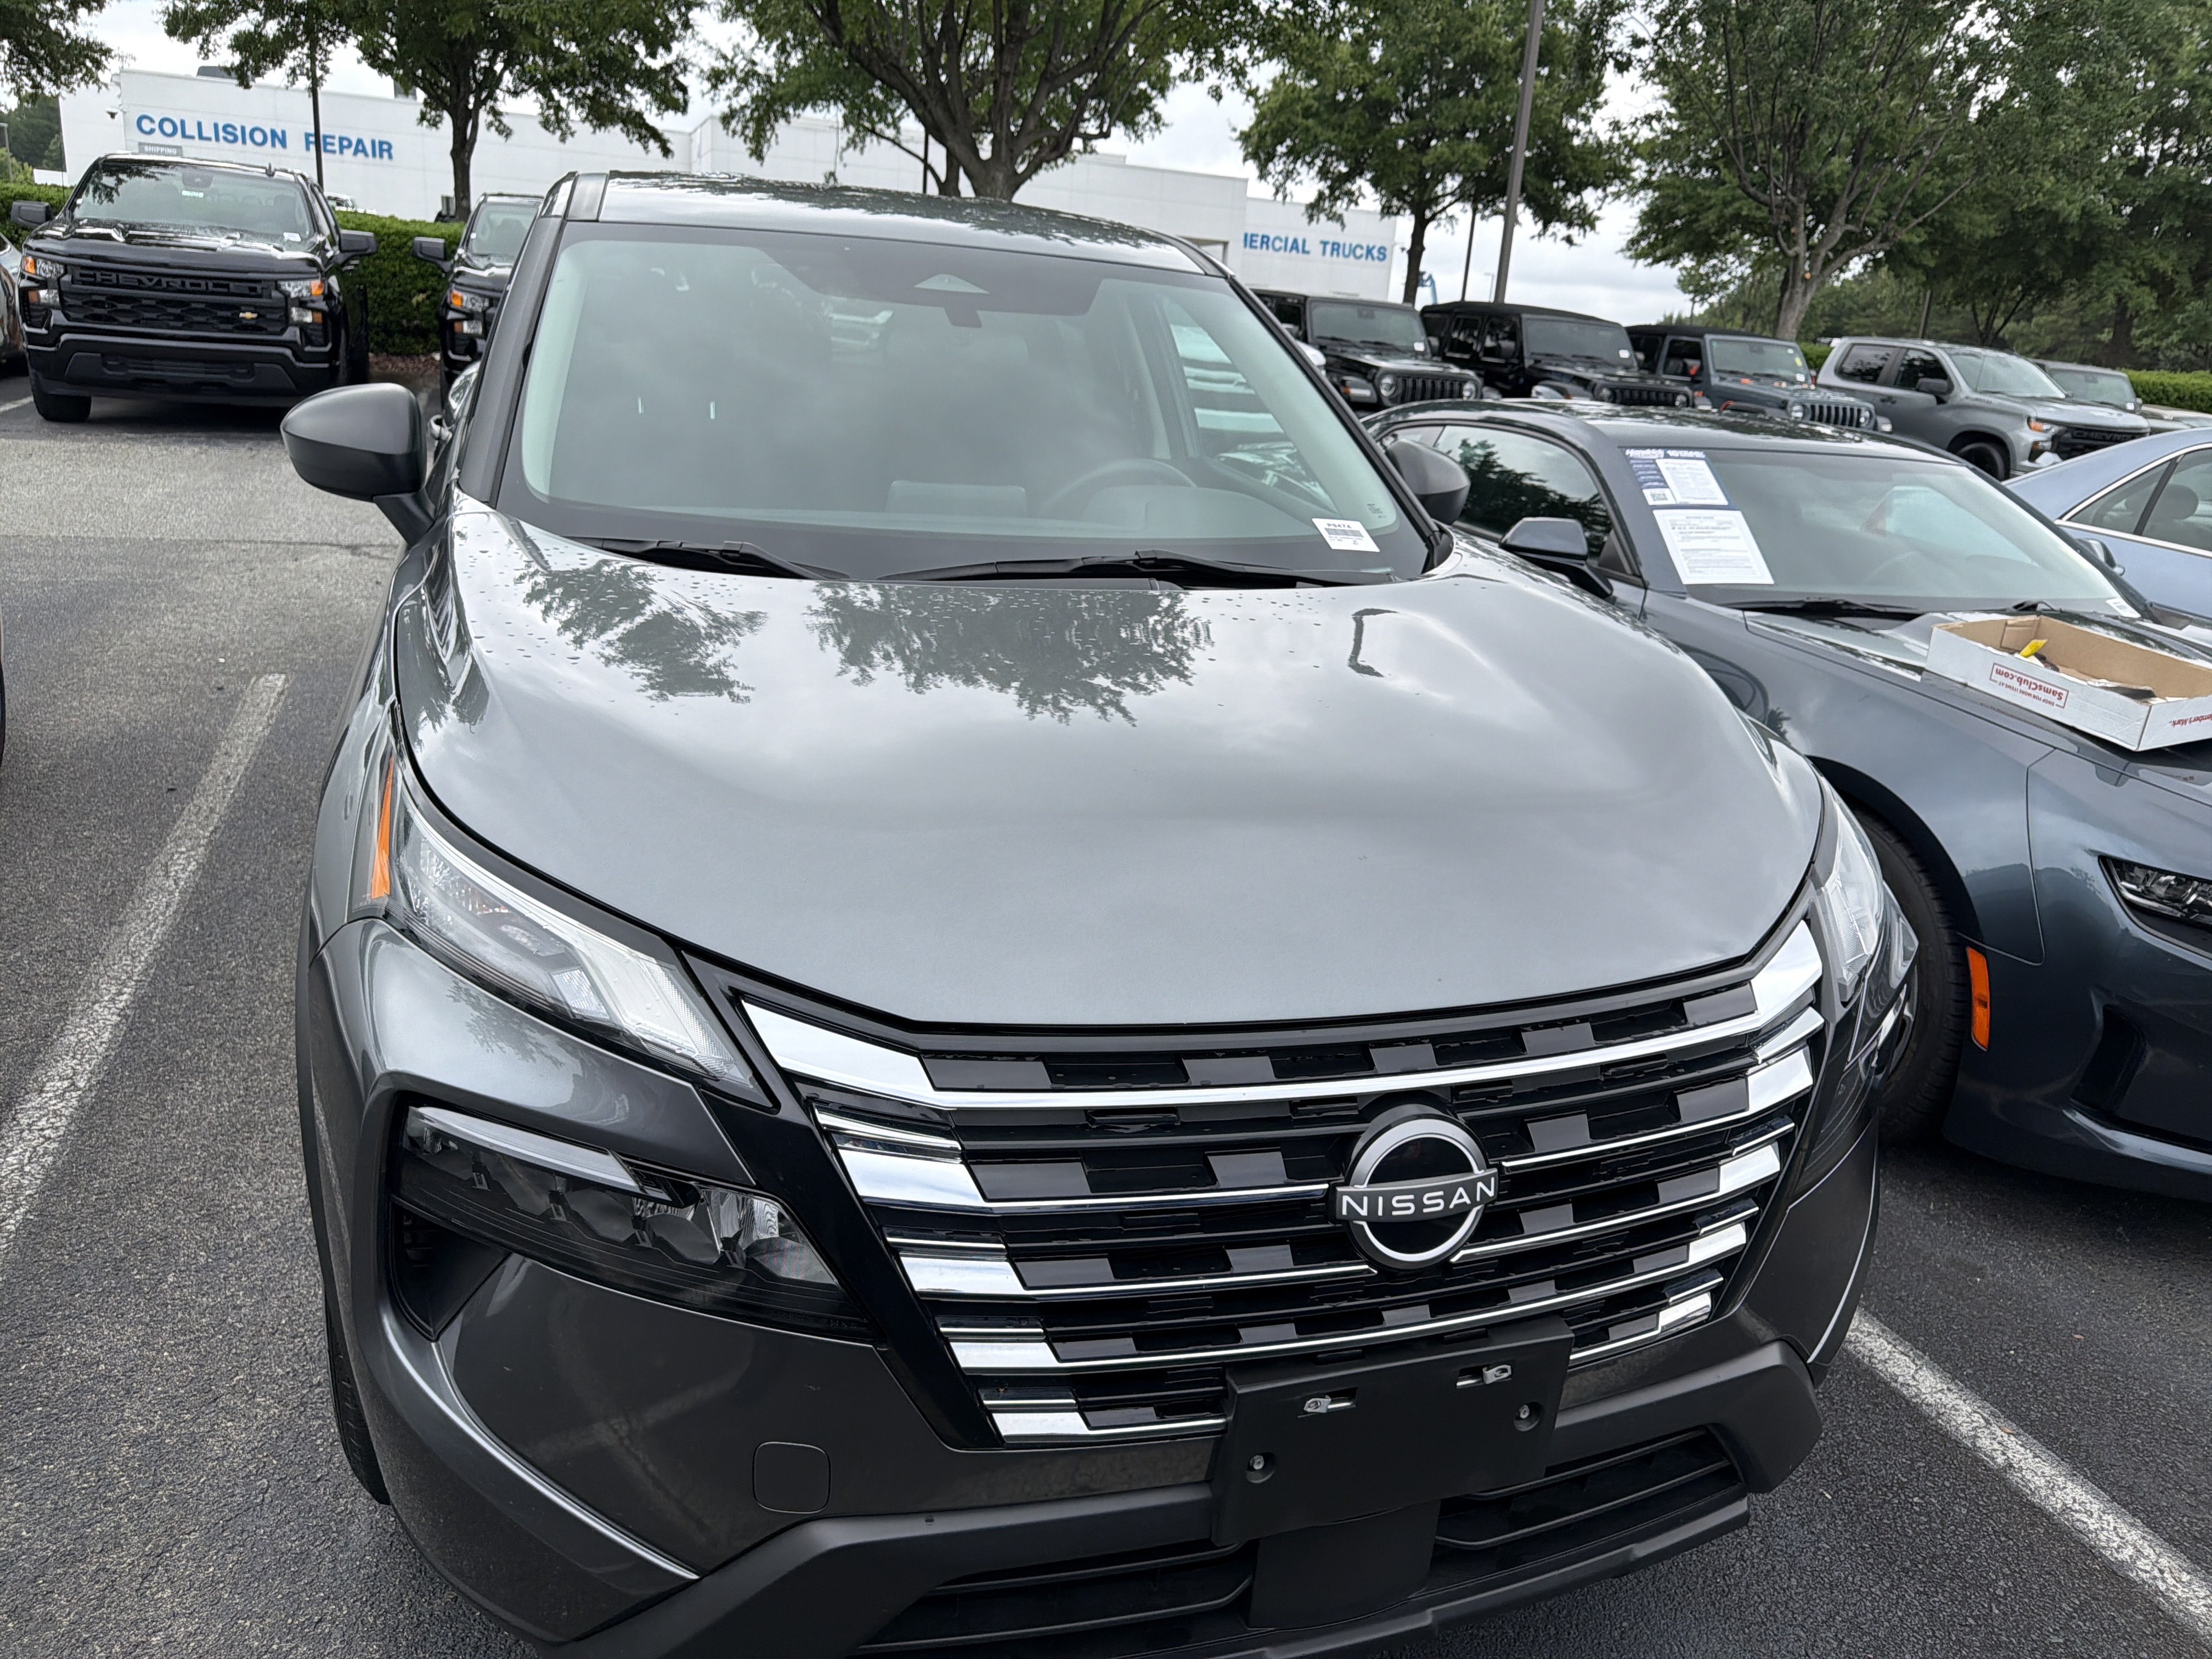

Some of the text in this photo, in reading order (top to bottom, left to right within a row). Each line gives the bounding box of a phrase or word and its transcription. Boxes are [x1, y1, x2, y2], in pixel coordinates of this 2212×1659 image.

[137, 114, 287, 149] COLLISION
[144, 145, 177, 154] SHIPPING
[1319, 240, 1387, 262] TRUCKS
[72, 268, 273, 298] CHEVROLET
[1995, 667, 2064, 701] SamsClub.com
[1342, 1177, 1495, 1216] NISSAN
